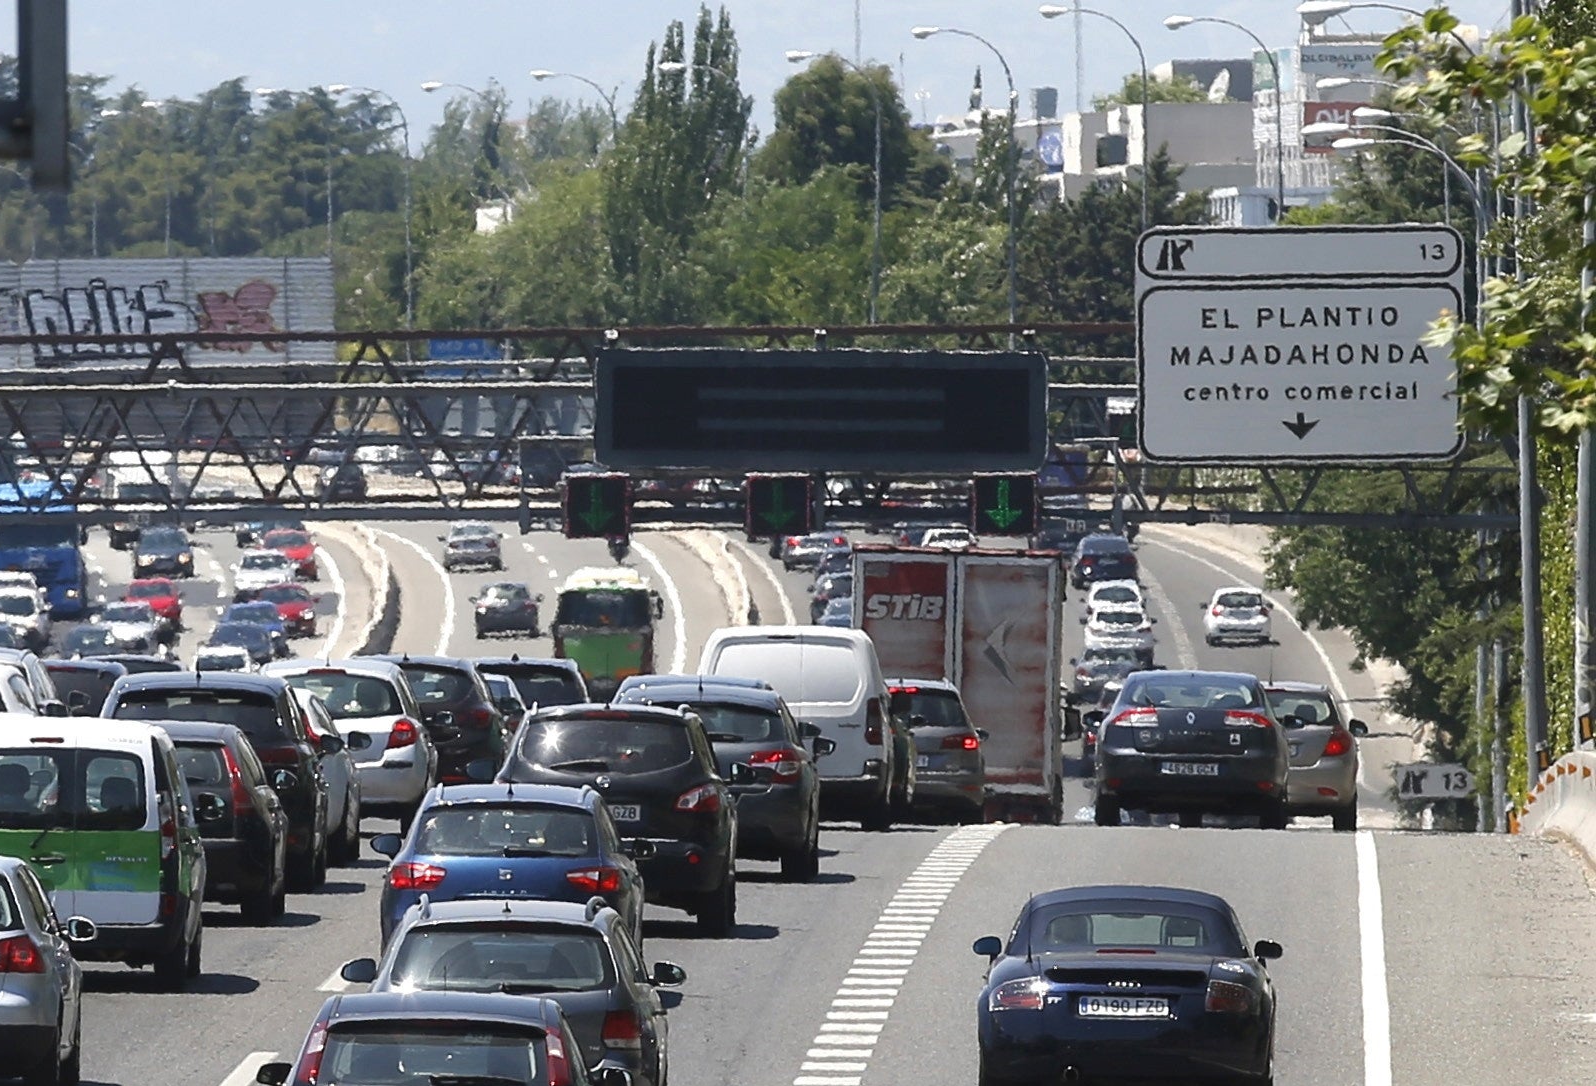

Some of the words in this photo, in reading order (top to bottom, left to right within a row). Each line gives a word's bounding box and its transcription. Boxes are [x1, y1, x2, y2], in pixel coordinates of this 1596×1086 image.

[1420, 244, 1445, 260] 13
[1201, 308, 1239, 329] EL
[1257, 306, 1398, 328] PLANTIO
[1170, 344, 1429, 366] MAJADAHONDA
[1184, 383, 1269, 401] centro
[1285, 381, 1418, 400] comercial
[1443, 772, 1467, 791] 13
[1092, 1000, 1130, 1013] 0190
[1135, 1001, 1164, 1014] FZD
